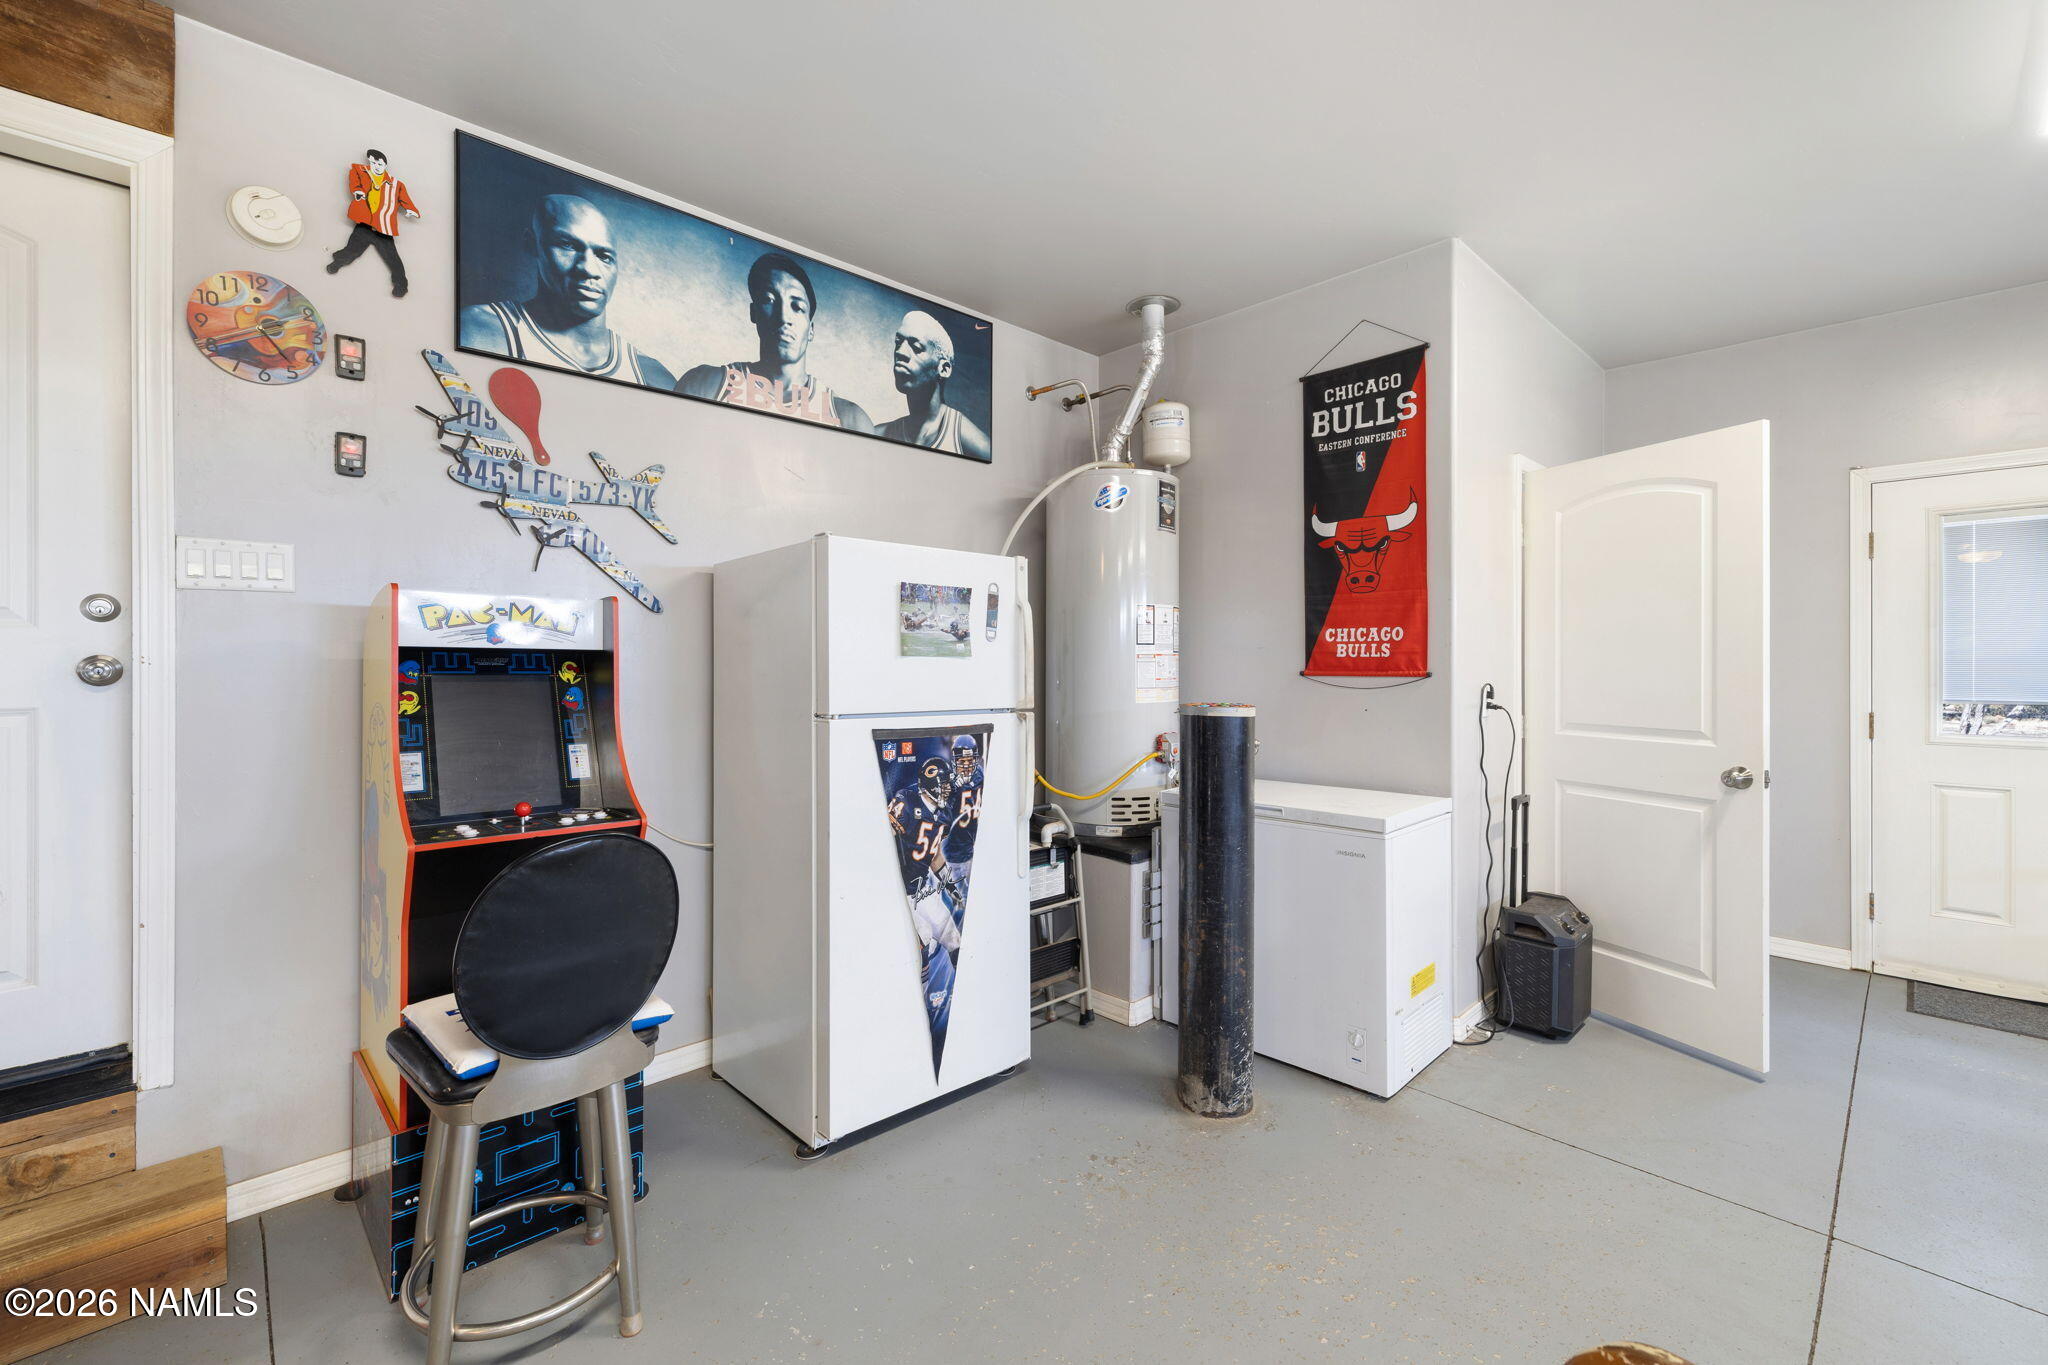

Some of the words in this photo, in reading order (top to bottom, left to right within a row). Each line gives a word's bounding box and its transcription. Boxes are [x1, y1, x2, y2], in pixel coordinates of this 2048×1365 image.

[219, 275, 239, 293] 11
[247, 274, 269, 292] 12
[197, 289, 219, 306] 10
[194, 313, 208, 327] 9
[302, 307, 315, 321] 2
[311, 330, 323, 345] 3
[305, 353, 320, 366] 4
[258, 368, 272, 382] 6
[287, 366, 299, 379] 5
[1324, 373, 1402, 403] CHICAGO
[746, 373, 841, 425] BULL
[1311, 390, 1418, 438] BULLS
[1318, 438, 1352, 452] EASTERN
[1354, 428, 1407, 445] CONFERENCE
[1325, 626, 1404, 642] CHICAGO
[1336, 643, 1391, 658] BULLS
[912, 821, 946, 861] 54
